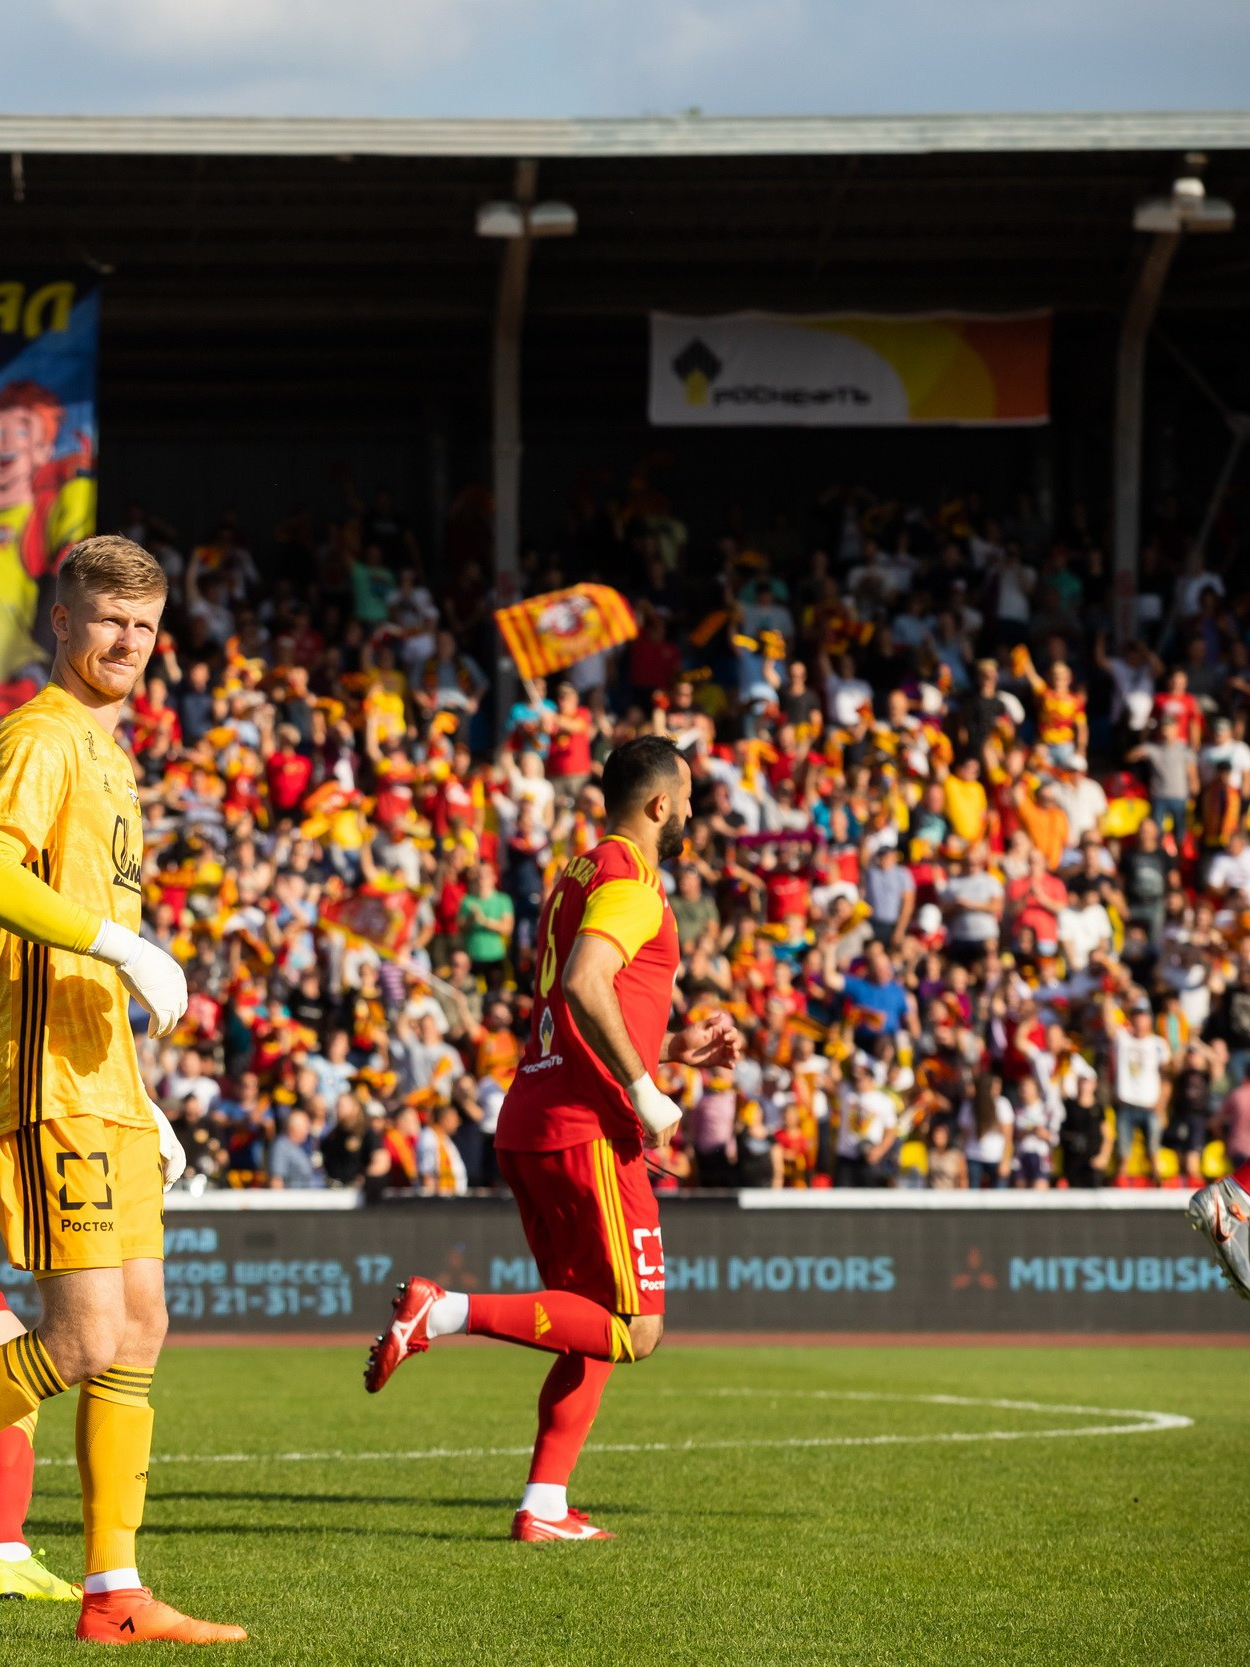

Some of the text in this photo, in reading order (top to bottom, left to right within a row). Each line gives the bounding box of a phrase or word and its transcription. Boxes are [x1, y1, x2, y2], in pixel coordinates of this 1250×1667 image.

[61, 1218, 115, 1233] Ростех
[355, 1254, 394, 1285] 17
[728, 1255, 895, 1292] MOTORS
[1009, 1256, 1230, 1293] MITSUBISH
